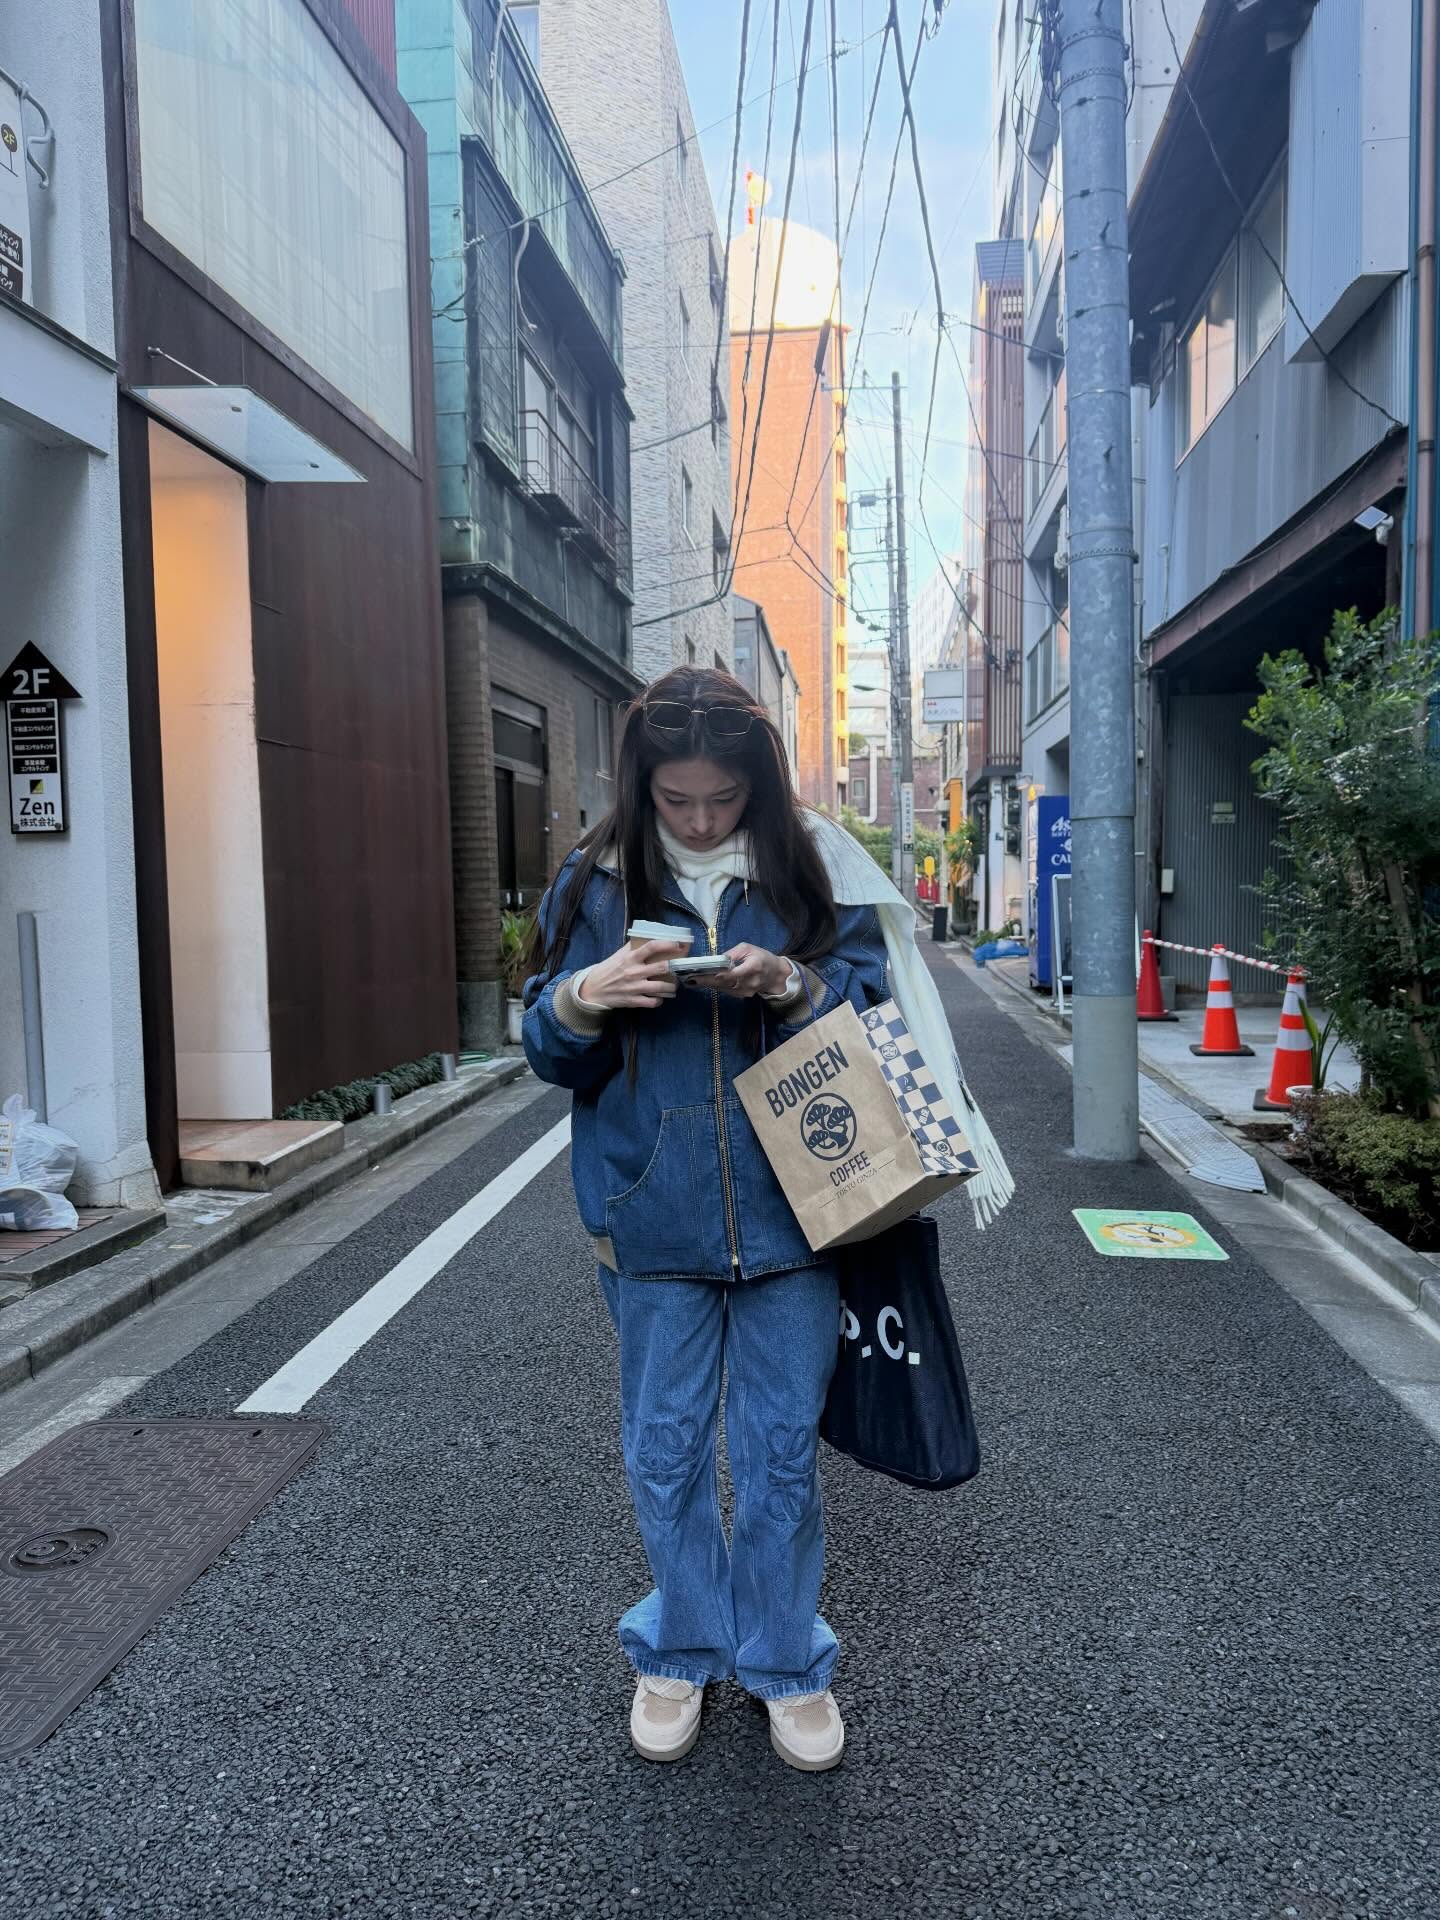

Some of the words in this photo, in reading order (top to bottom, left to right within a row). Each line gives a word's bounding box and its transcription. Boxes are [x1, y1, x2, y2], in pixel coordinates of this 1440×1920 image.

[3, 129, 15, 145] 2F
[13, 668, 50, 695] 2F
[20, 798, 55, 815] Zen
[20, 817, 56, 827] 株式会社
[765, 1041, 849, 1118] BONGEN
[830, 1151, 871, 1187] COFFEE
[834, 1180, 857, 1199] TOKYO
[856, 1167, 878, 1184] GINZA
